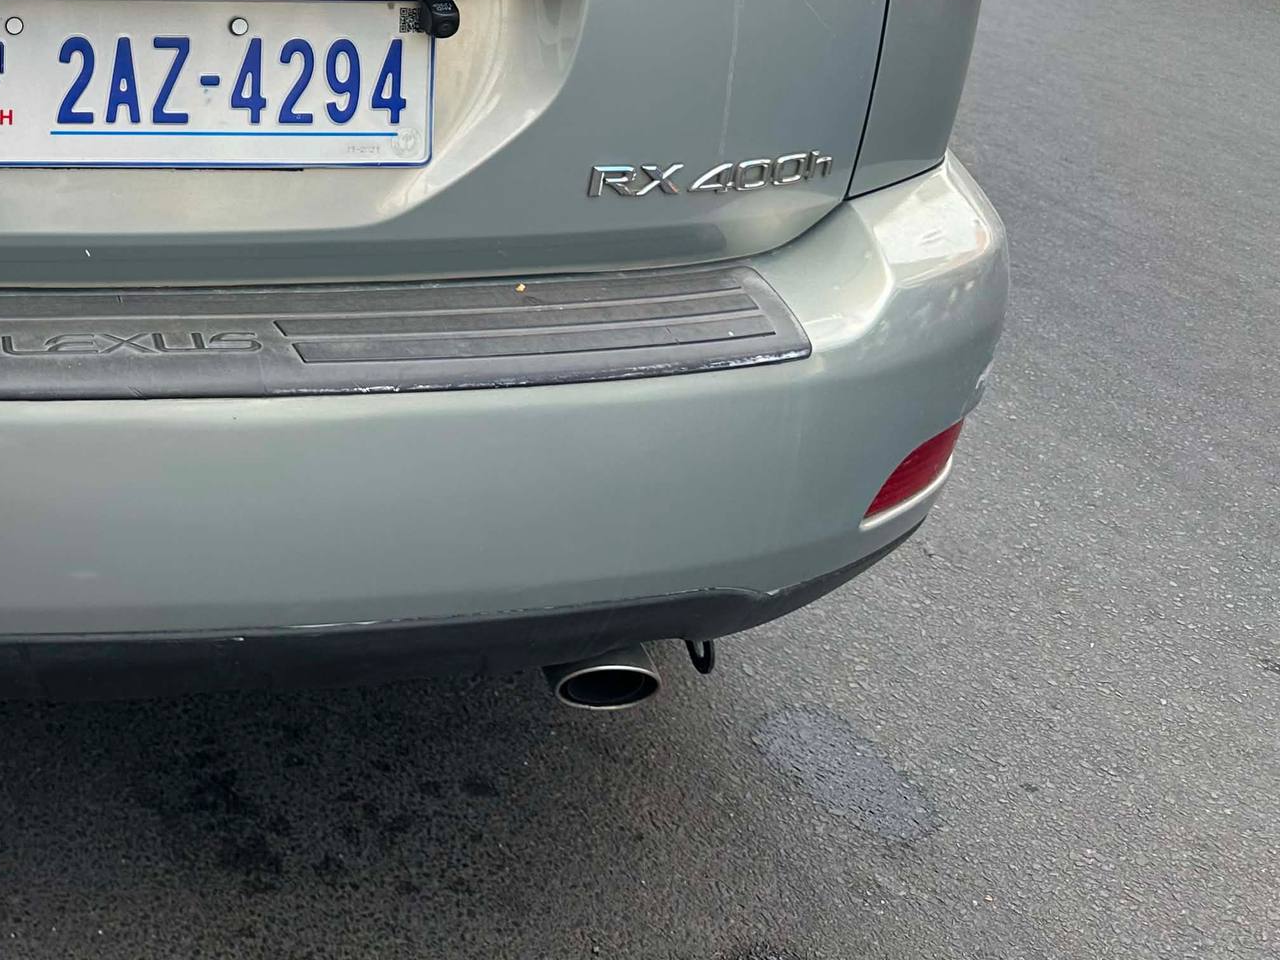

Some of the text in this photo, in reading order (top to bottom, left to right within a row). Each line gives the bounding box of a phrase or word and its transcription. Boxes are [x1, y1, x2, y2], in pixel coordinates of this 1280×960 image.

[56, 35, 407, 125] 2AZ-4294
[587, 150, 833, 197] RX 400h
[1, 331, 263, 356] LEXUS
